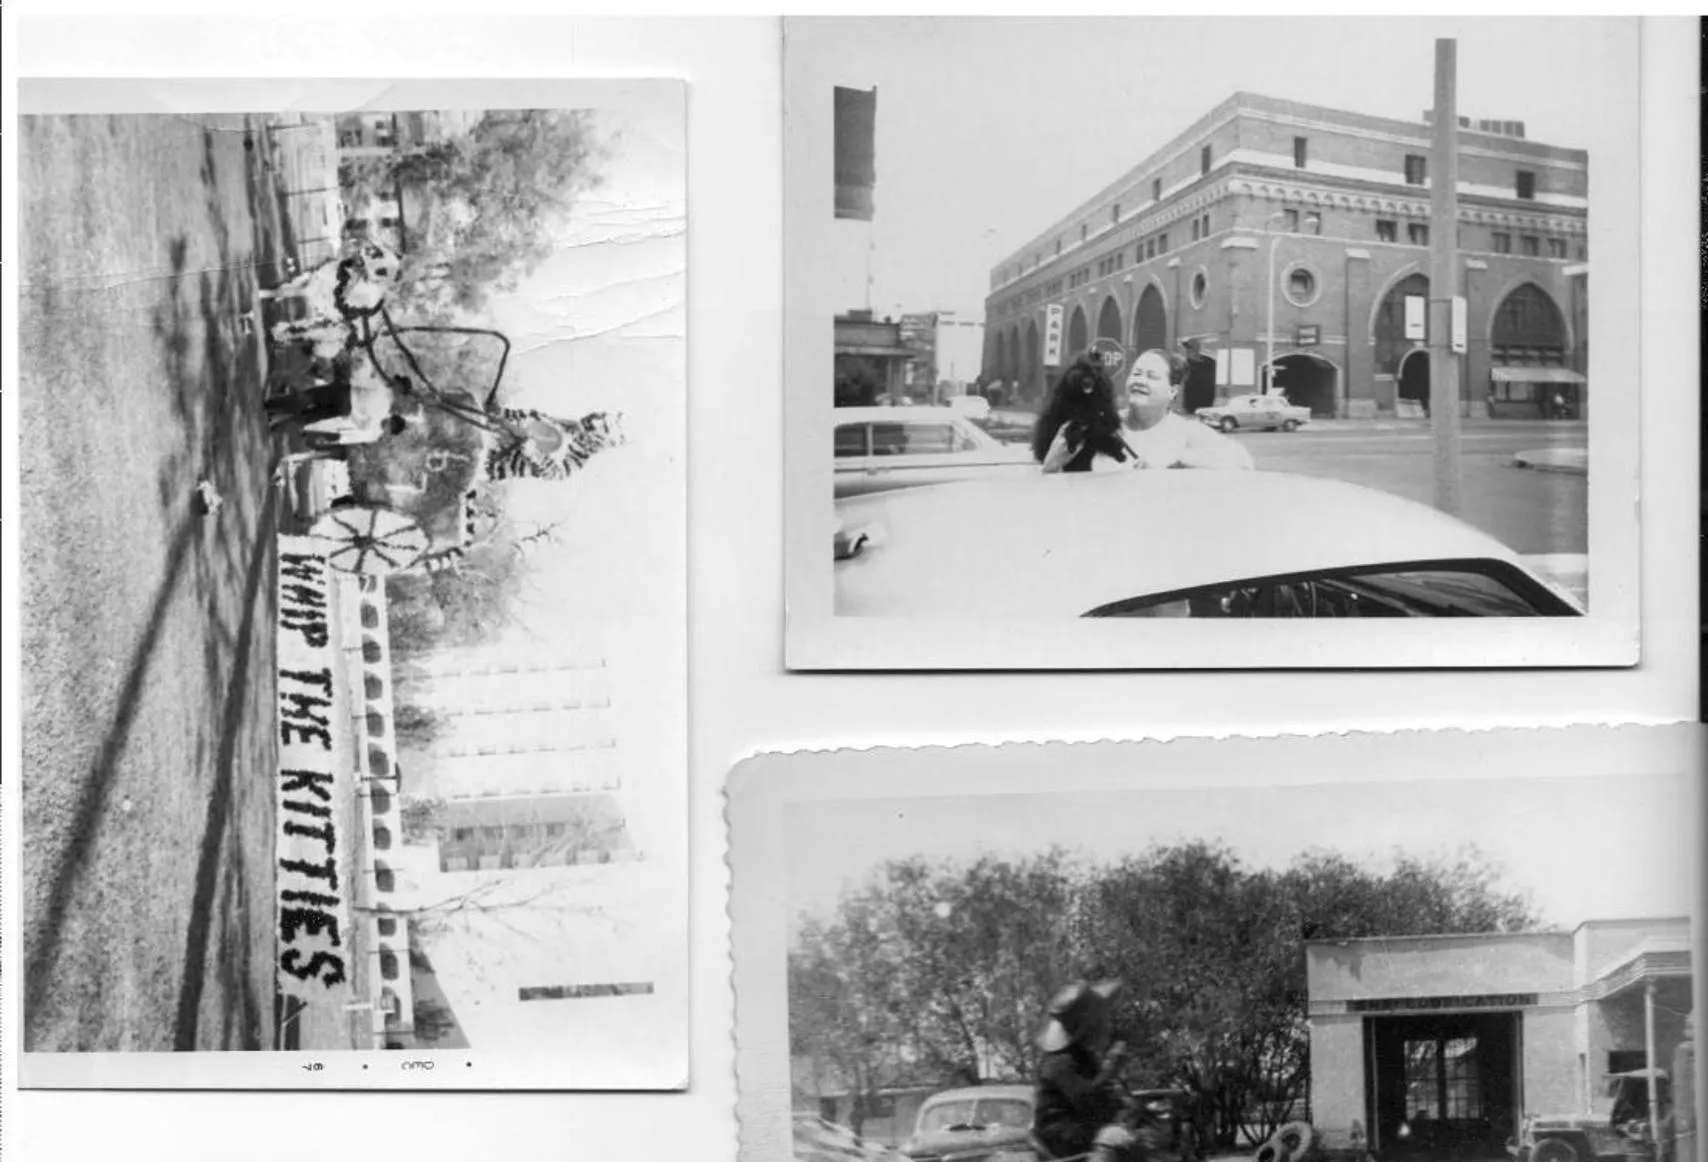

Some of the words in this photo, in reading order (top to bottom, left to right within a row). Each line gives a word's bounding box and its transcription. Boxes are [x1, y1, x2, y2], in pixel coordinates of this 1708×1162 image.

[1049, 307, 1060, 357] PARK
[279, 552, 330, 648] WHIP
[279, 667, 333, 751] THE
[278, 769, 346, 989] KITTIES
